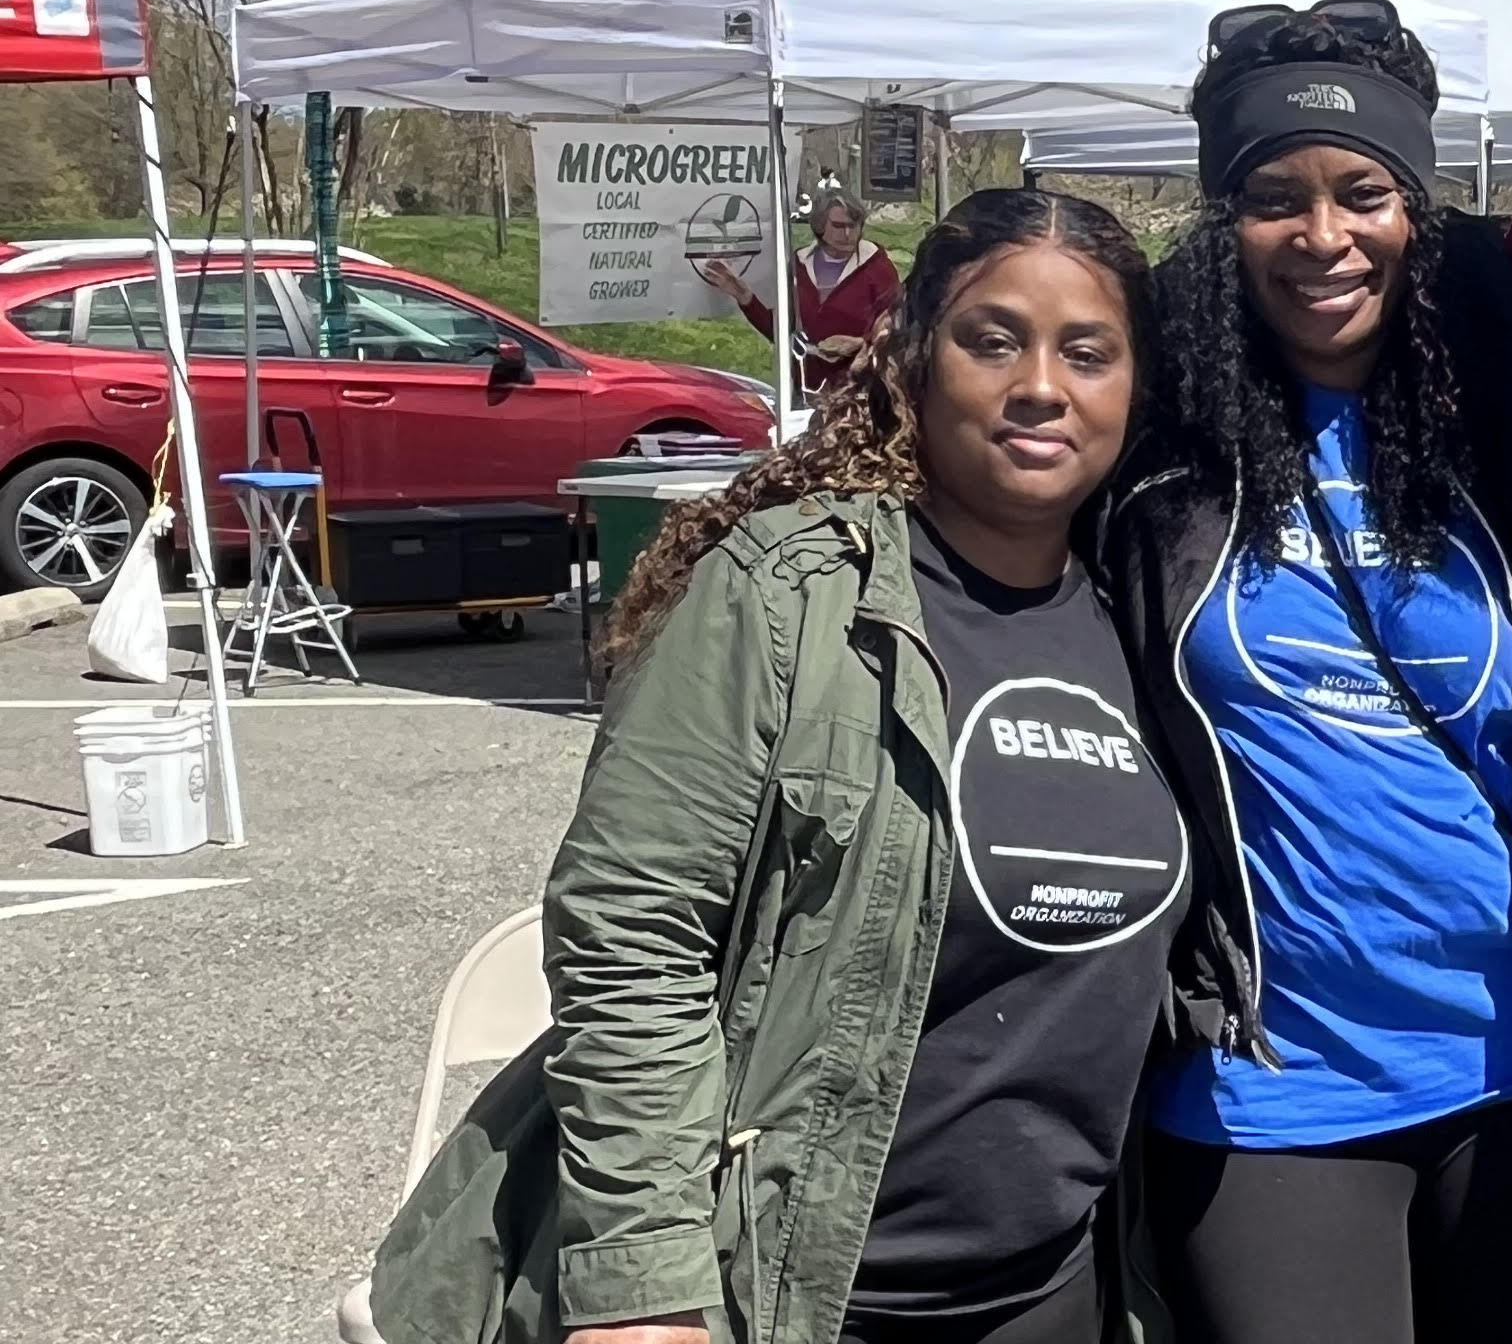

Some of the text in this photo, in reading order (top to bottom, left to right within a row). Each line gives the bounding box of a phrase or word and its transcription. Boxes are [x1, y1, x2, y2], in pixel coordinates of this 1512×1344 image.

[557, 142, 774, 186] MICROGREEN
[596, 190, 641, 210] LOCAL
[582, 221, 659, 240] CERTIFIED
[589, 250, 653, 270] NATURAL
[589, 279, 650, 300] GROWER
[1320, 674, 1400, 697] NONPR
[989, 717, 1140, 774] BELIEVE
[1030, 884, 1124, 909] NONPROFIT
[1010, 905, 1127, 926] ORGANIZATION
